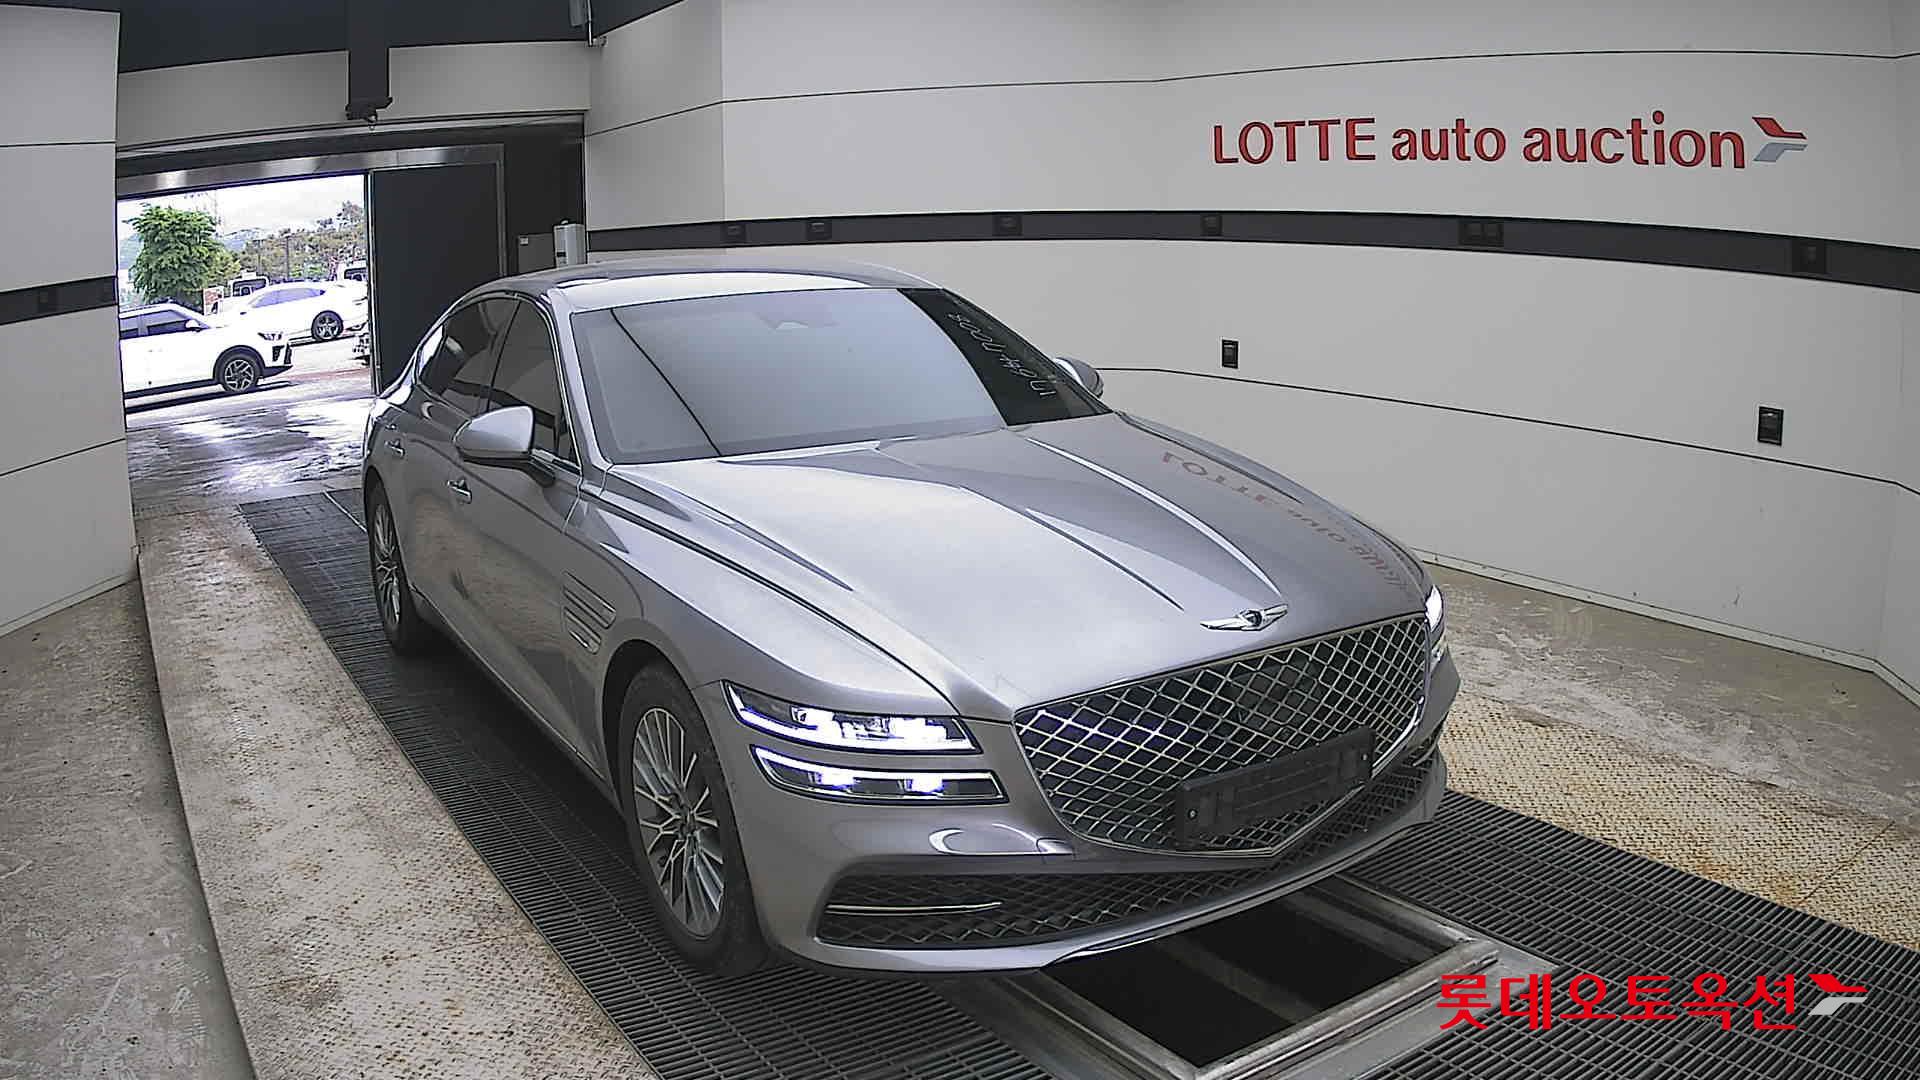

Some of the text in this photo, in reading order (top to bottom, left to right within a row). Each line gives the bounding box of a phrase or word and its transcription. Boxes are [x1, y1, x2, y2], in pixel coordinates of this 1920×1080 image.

[1213, 111, 1746, 169] LOTTE auto auction
